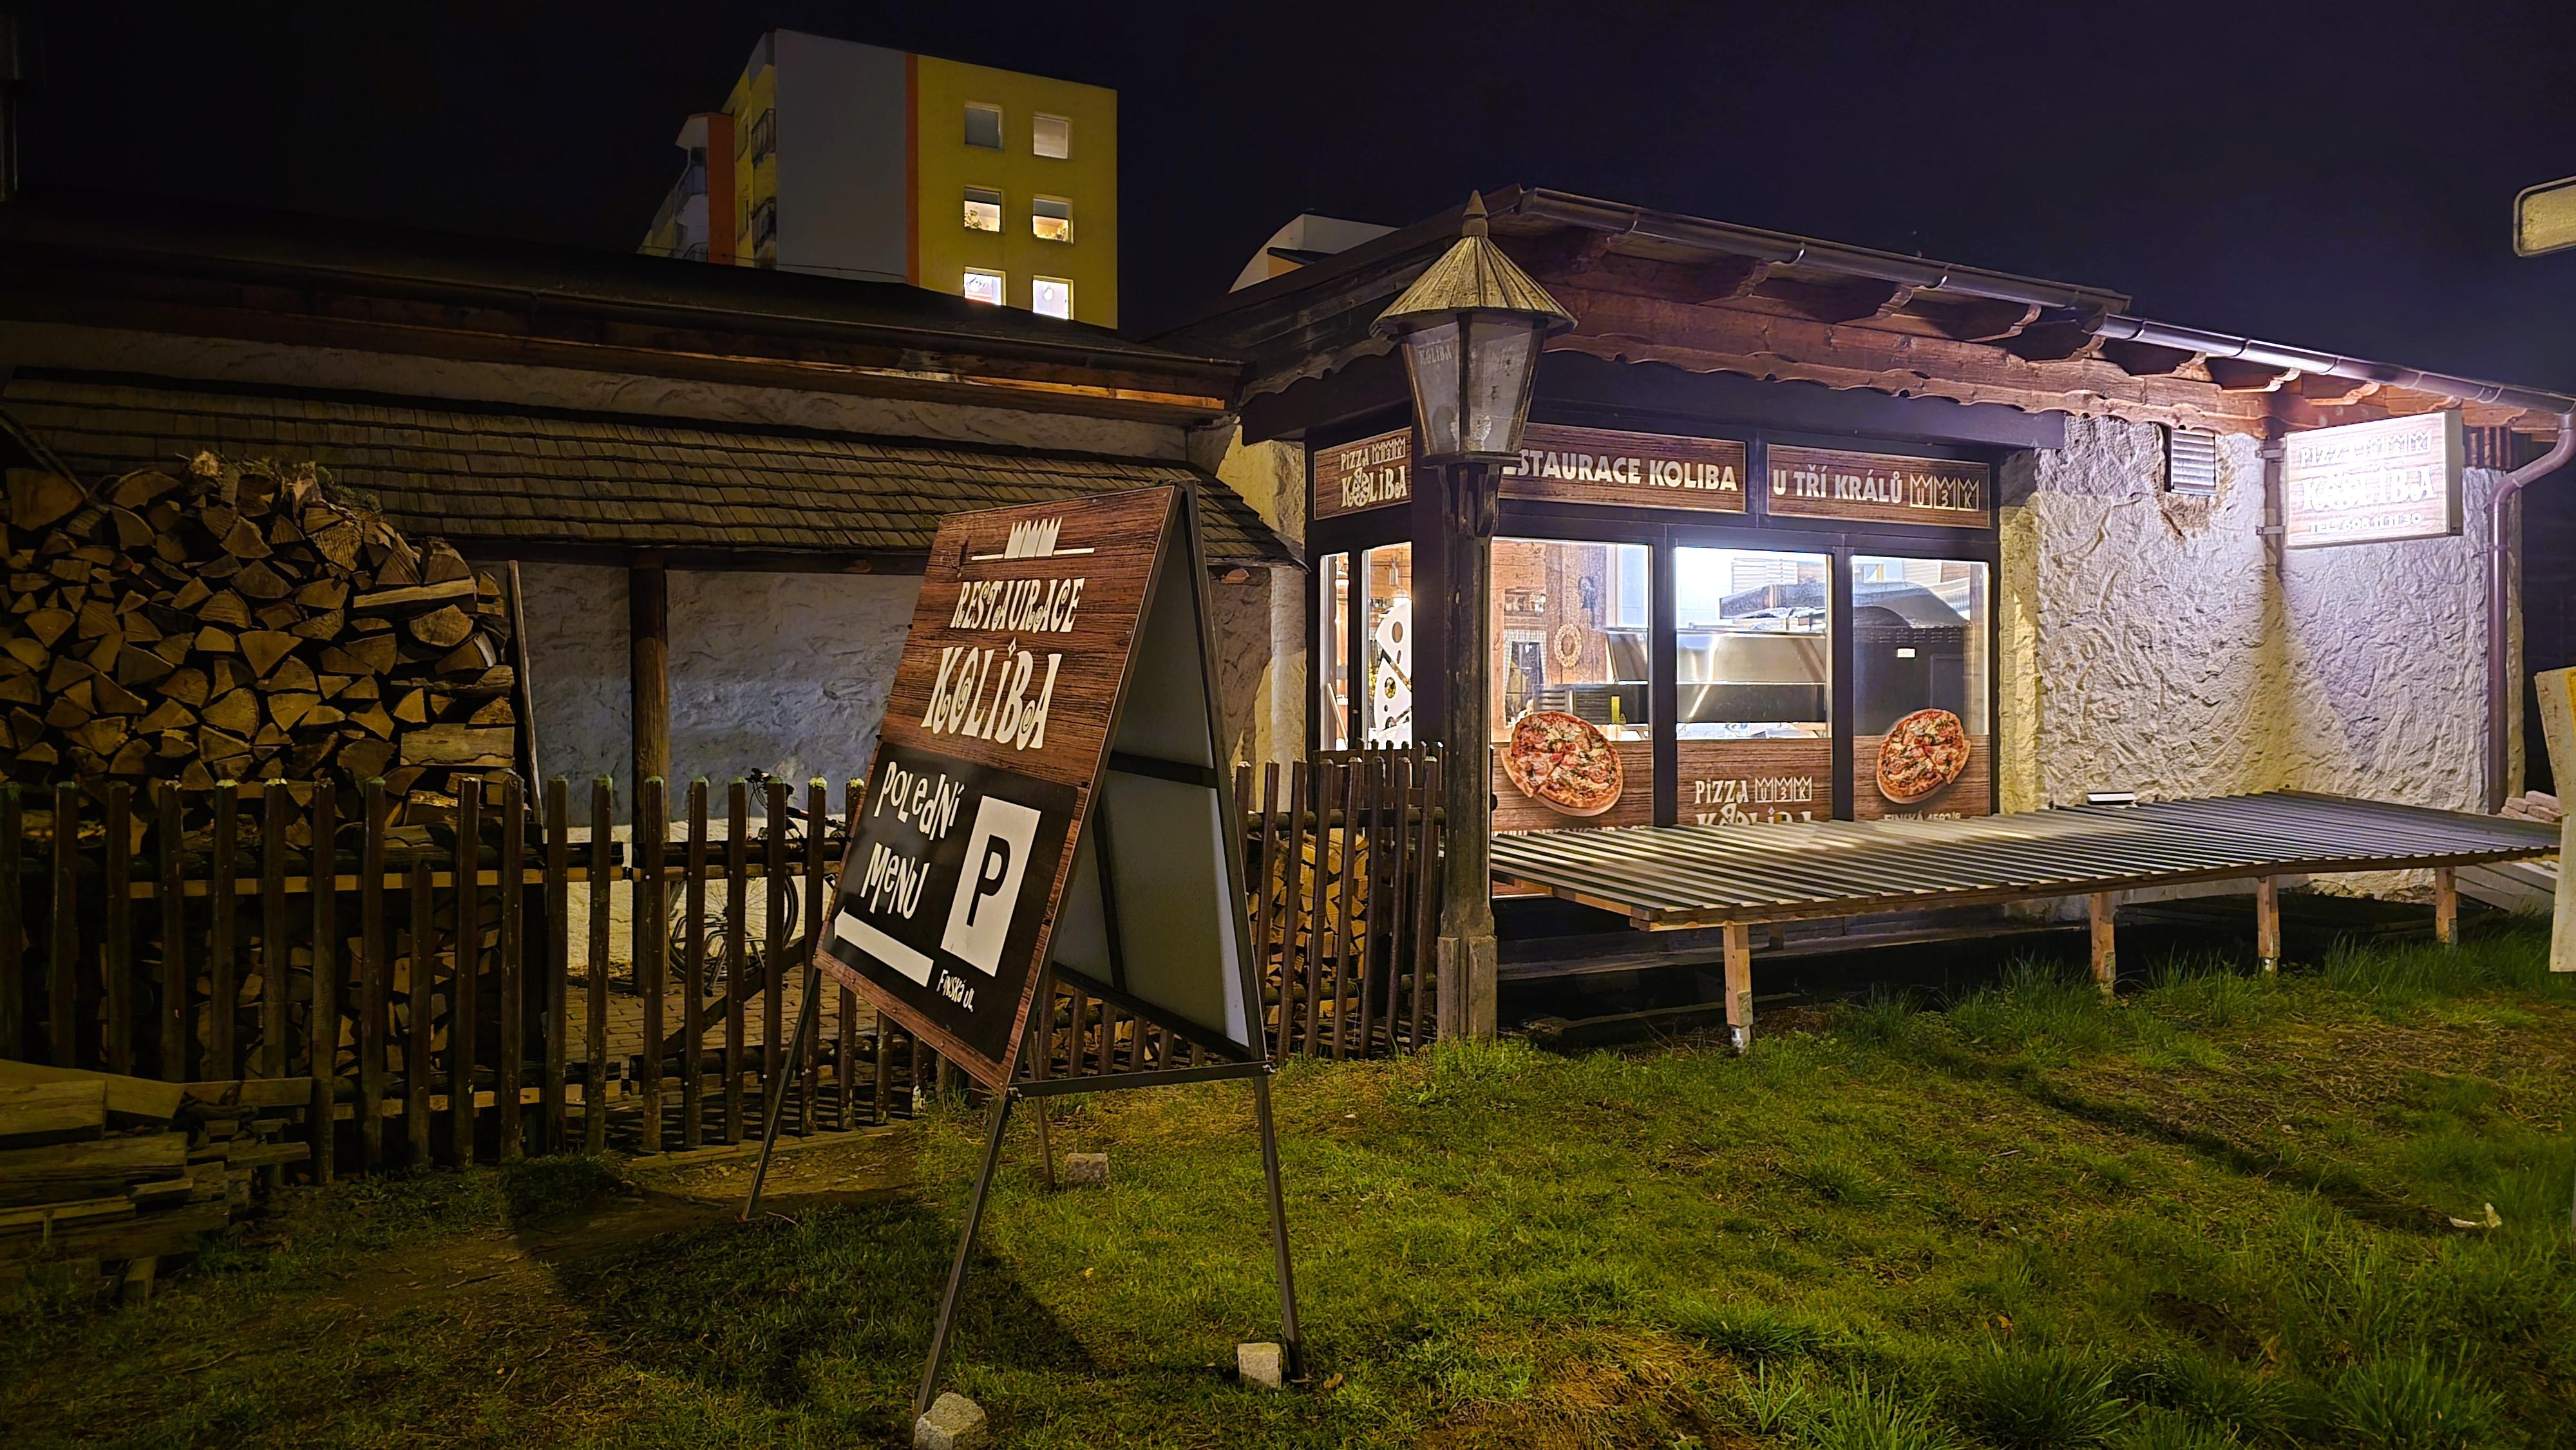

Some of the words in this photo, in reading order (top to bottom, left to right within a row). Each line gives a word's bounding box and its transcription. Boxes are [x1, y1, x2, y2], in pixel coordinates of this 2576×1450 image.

[1503, 449, 1641, 485] STAURACE
[1649, 459, 1738, 491] KOLIBA
[1773, 470, 1786, 495] U
[1794, 464, 1828, 498] TŘÍ
[1835, 469, 1903, 504] KRÁLŮ
[950, 578, 1084, 634] RESTAURACE
[966, 834, 1010, 927] P
